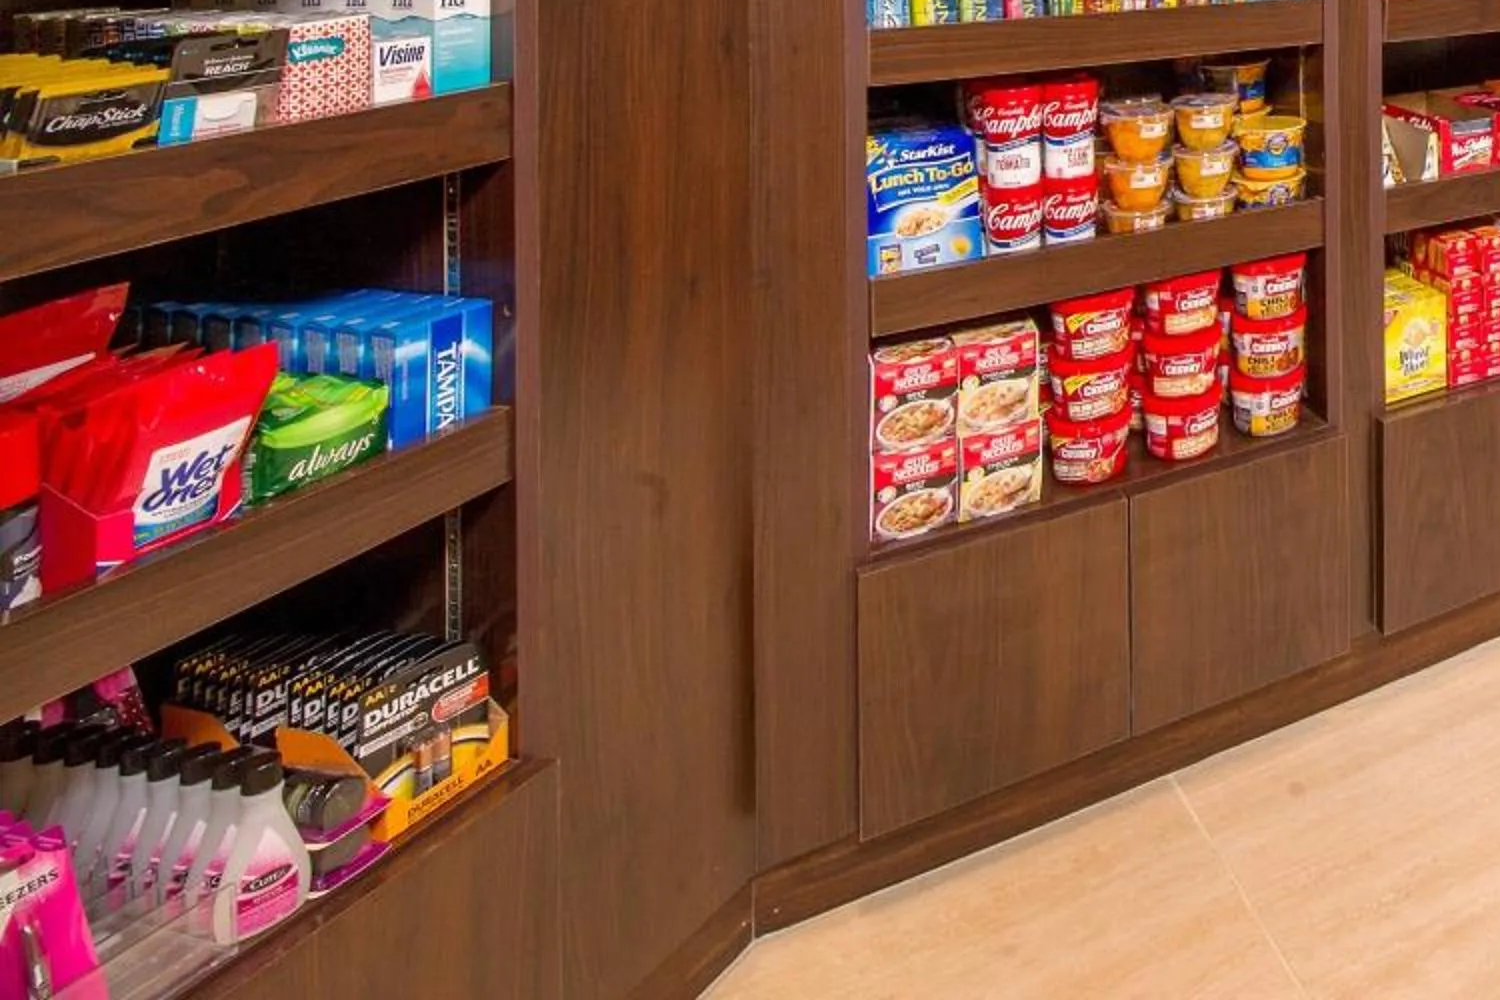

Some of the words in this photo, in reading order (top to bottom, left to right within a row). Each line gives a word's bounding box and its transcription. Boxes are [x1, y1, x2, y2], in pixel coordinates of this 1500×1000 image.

[204, 61, 251, 76] REACH
[379, 42, 425, 67] Visine
[45, 103, 148, 132] ChapStick
[900, 143, 956, 162] StarKist
[870, 169, 925, 197] Lunch
[927, 161, 974, 182] To-Go
[437, 341, 457, 430] TAMPA
[161, 443, 235, 487] Wet
[288, 431, 374, 482] always
[363, 657, 481, 730] DURACELL
[365, 691, 385, 707] AA
[407, 777, 463, 821] DURACELL
